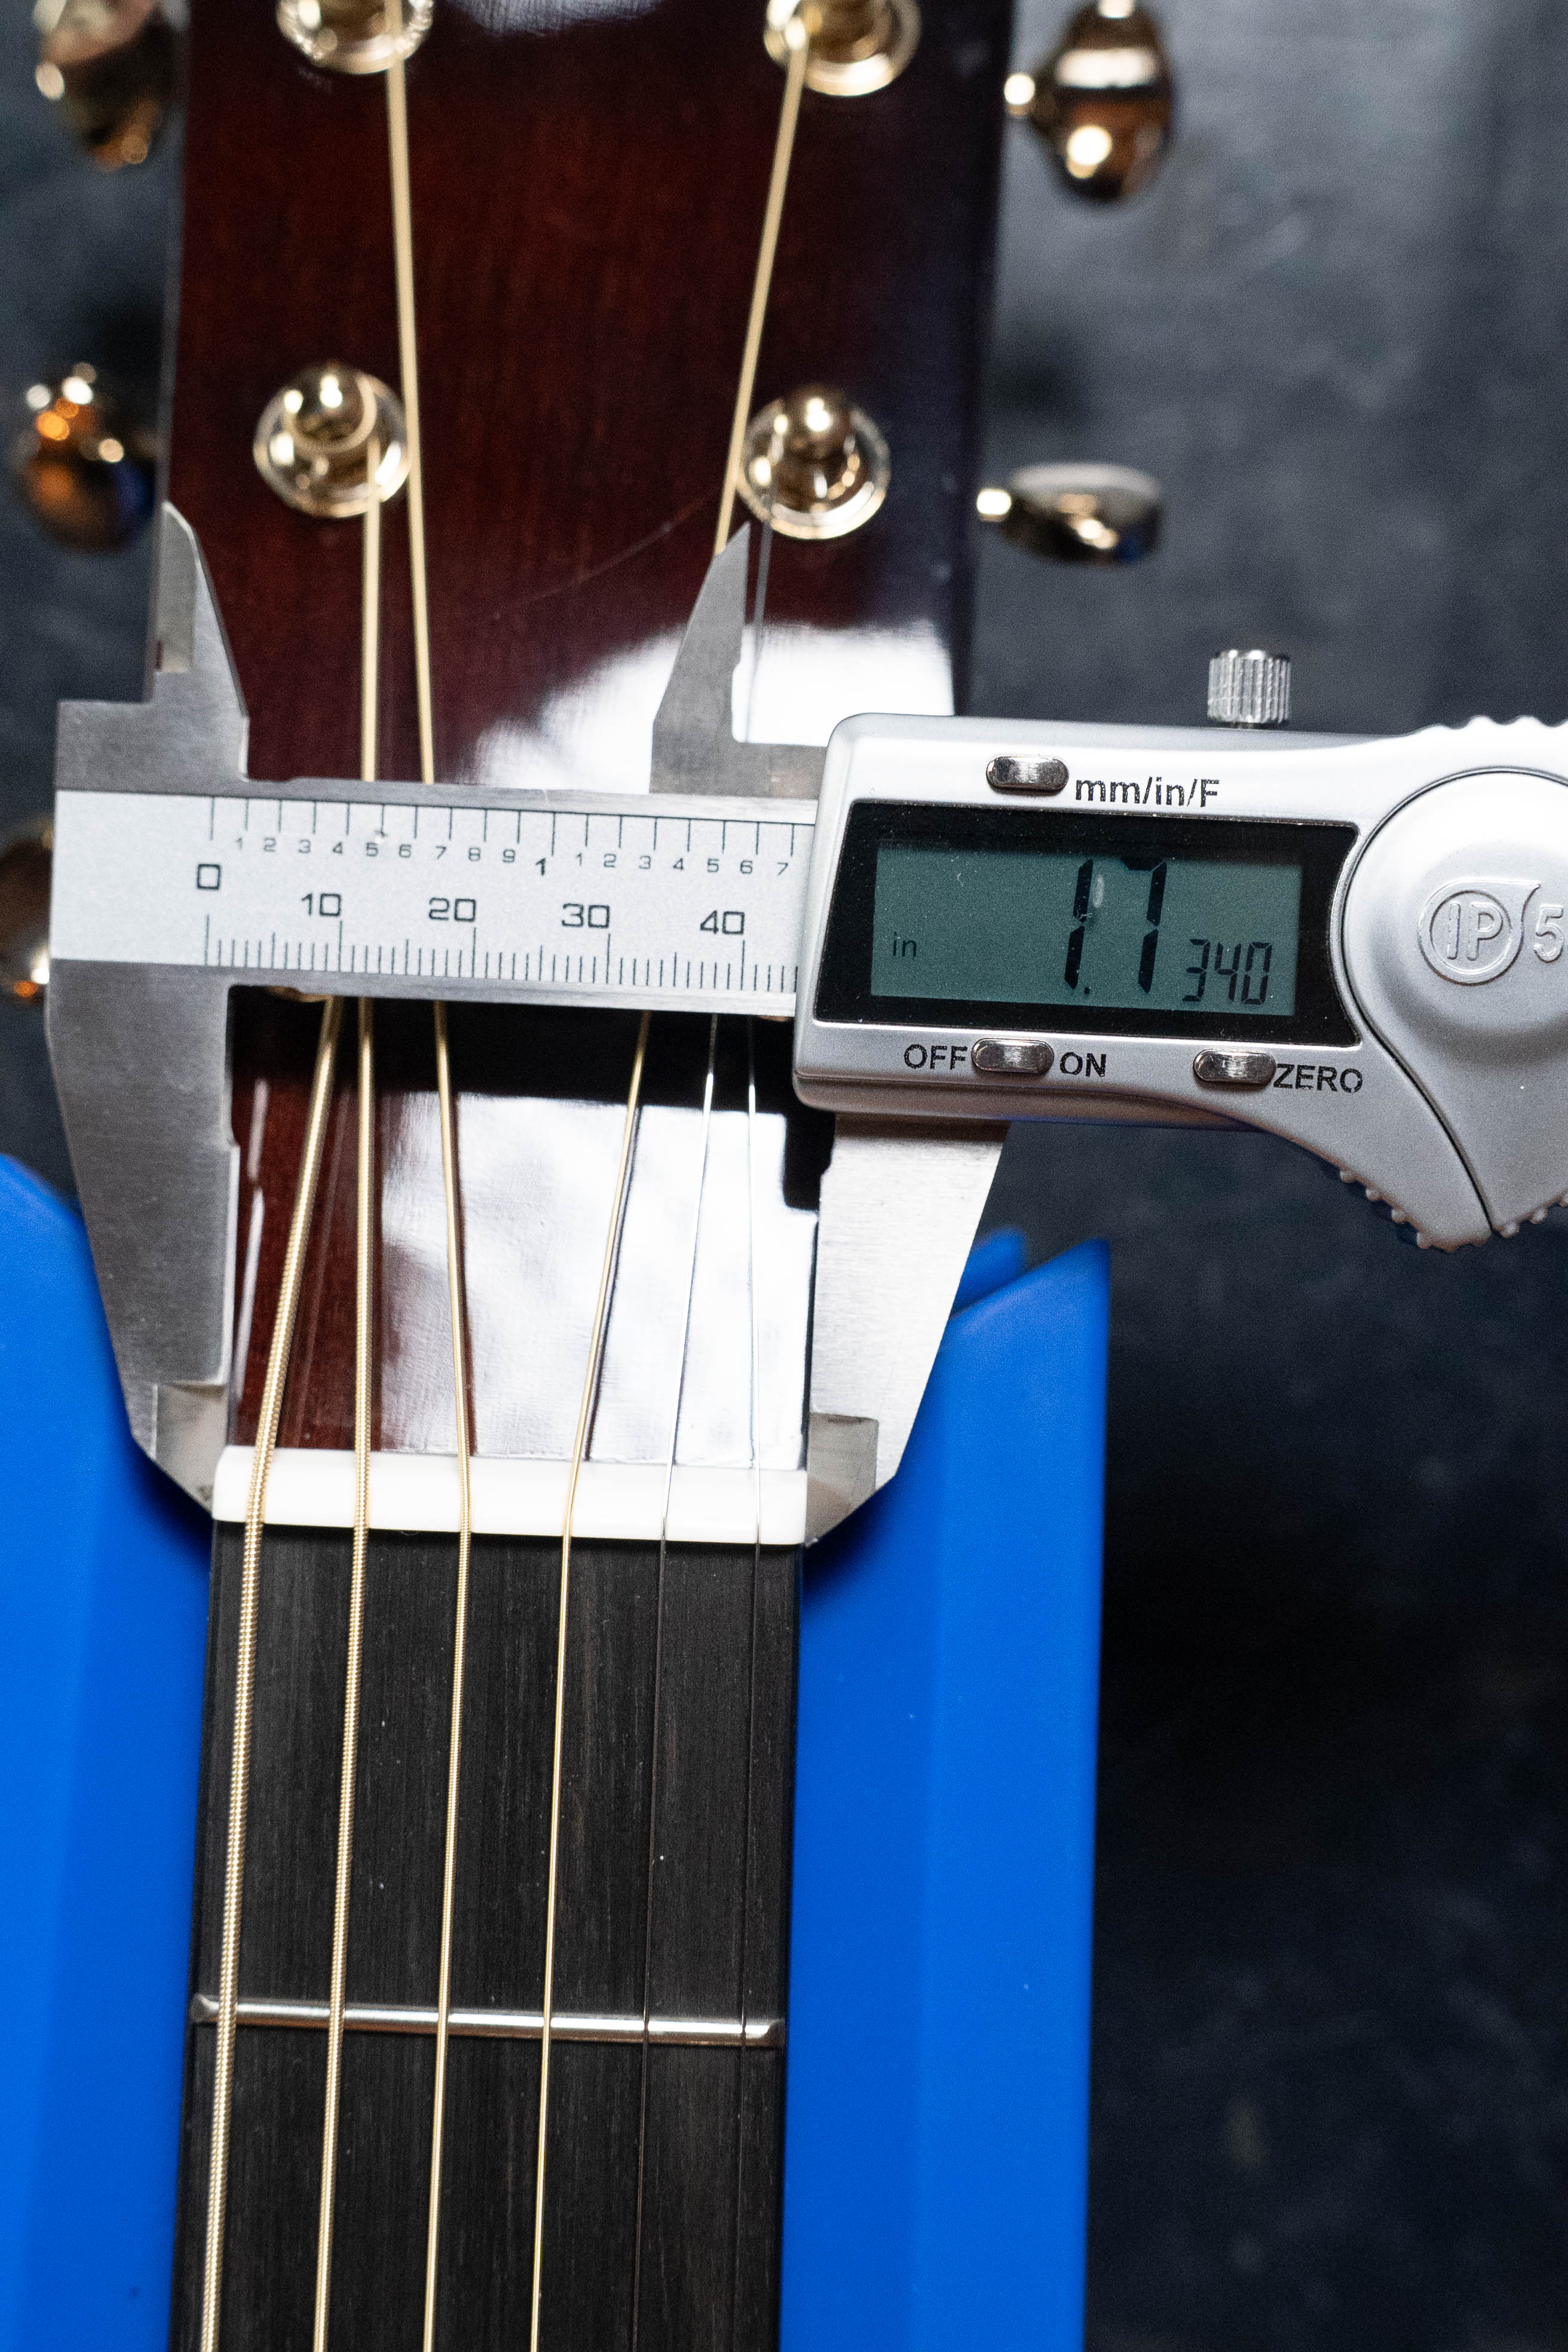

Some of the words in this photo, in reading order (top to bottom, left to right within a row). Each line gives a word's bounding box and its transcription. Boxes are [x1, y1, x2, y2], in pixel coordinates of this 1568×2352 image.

[1075, 776, 1220, 808] mm/in/F
[263, 837, 277, 853] 2
[298, 839, 311, 854] 3
[332, 841, 344, 856] 4
[365, 841, 379, 858] 5
[398, 843, 412, 859] 6
[435, 845, 448, 860] 7
[468, 846, 482, 862] 8
[502, 849, 516, 864] 9
[604, 853, 617, 869] 2
[639, 855, 652, 870] 3
[672, 857, 685, 872] 4
[706, 858, 720, 874] 5
[740, 859, 754, 875] 6
[777, 862, 789, 877] 7
[195, 862, 222, 892] 0
[300, 892, 343, 918] 10
[428, 896, 477, 924] 20
[561, 902, 611, 930] 30
[699, 909, 746, 936] 40
[892, 932, 918, 958] in
[904, 1044, 968, 1070] OFF
[1059, 1051, 1107, 1078] ON
[1273, 1062, 1364, 1094] ZERO
